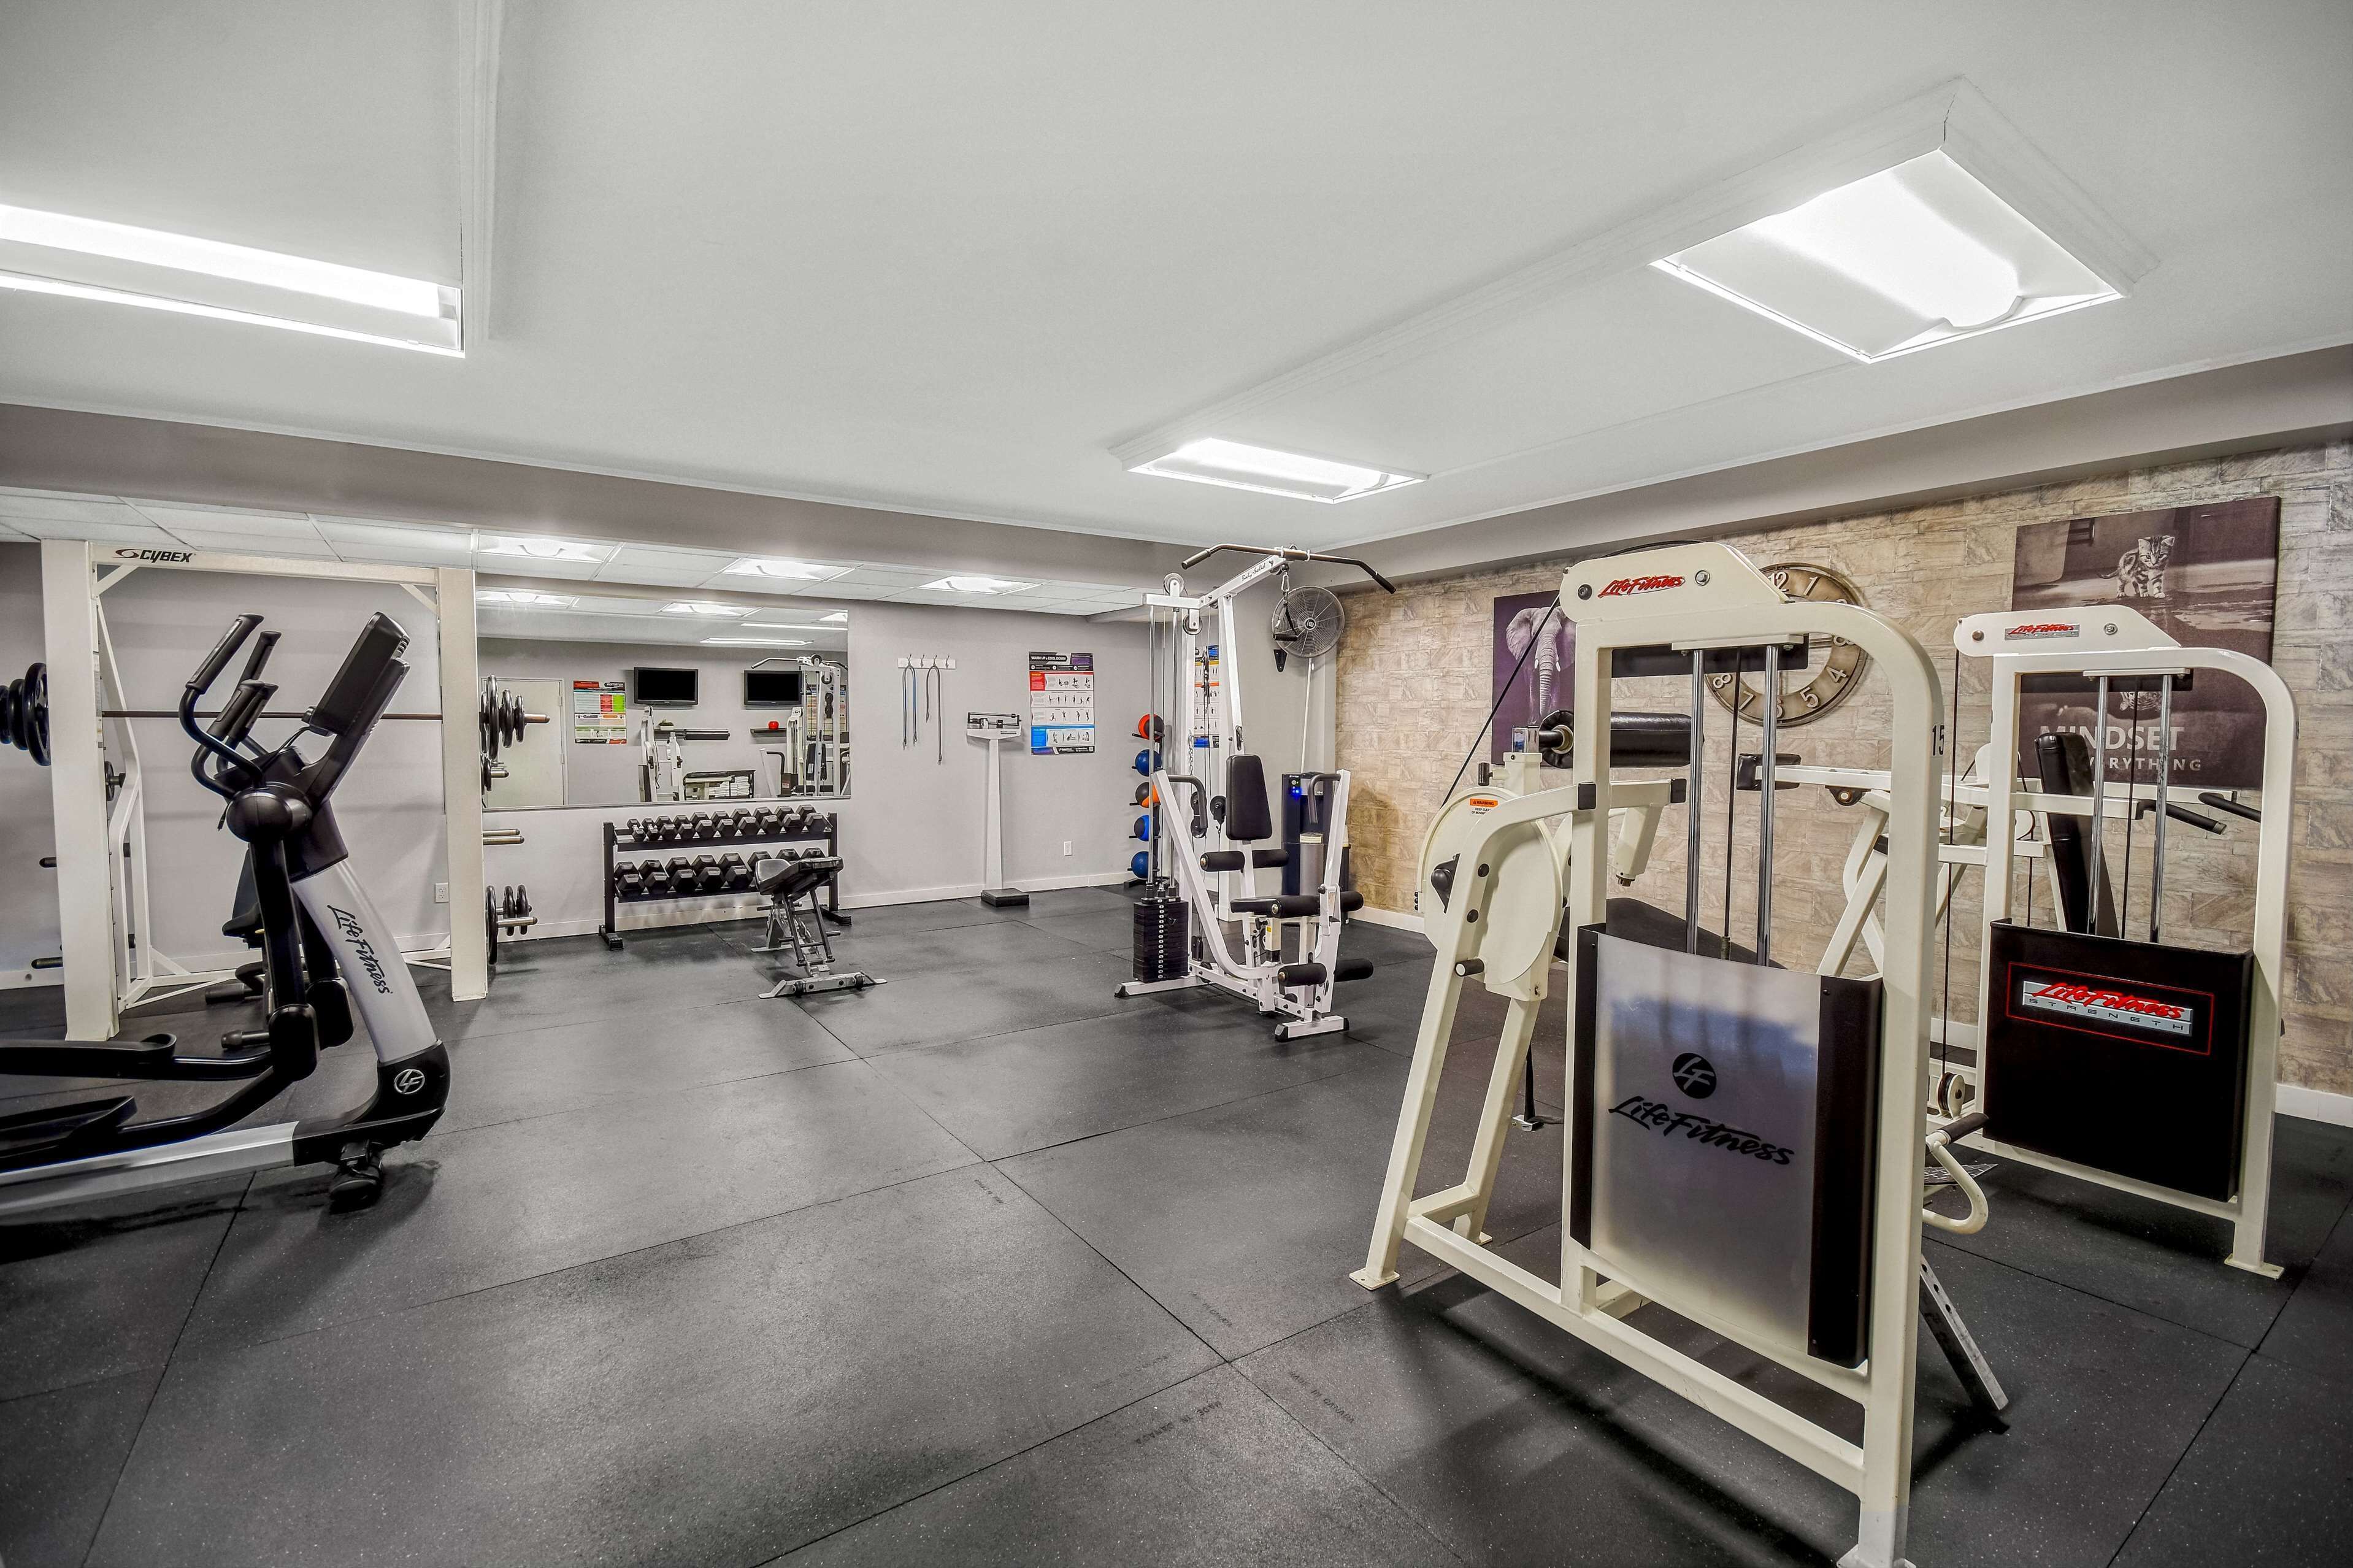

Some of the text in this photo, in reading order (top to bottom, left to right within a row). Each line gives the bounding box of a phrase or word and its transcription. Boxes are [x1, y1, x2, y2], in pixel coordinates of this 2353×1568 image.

[140, 550, 193, 563] CYBEX
[1804, 575, 1821, 596] 1
[1713, 672, 1732, 690] 8
[1825, 666, 1848, 684] 4
[1738, 690, 1756, 710] 7
[1800, 686, 1820, 709] 5
[1932, 725, 1944, 756] 15
[2029, 998, 2184, 1031] STRENGTH
